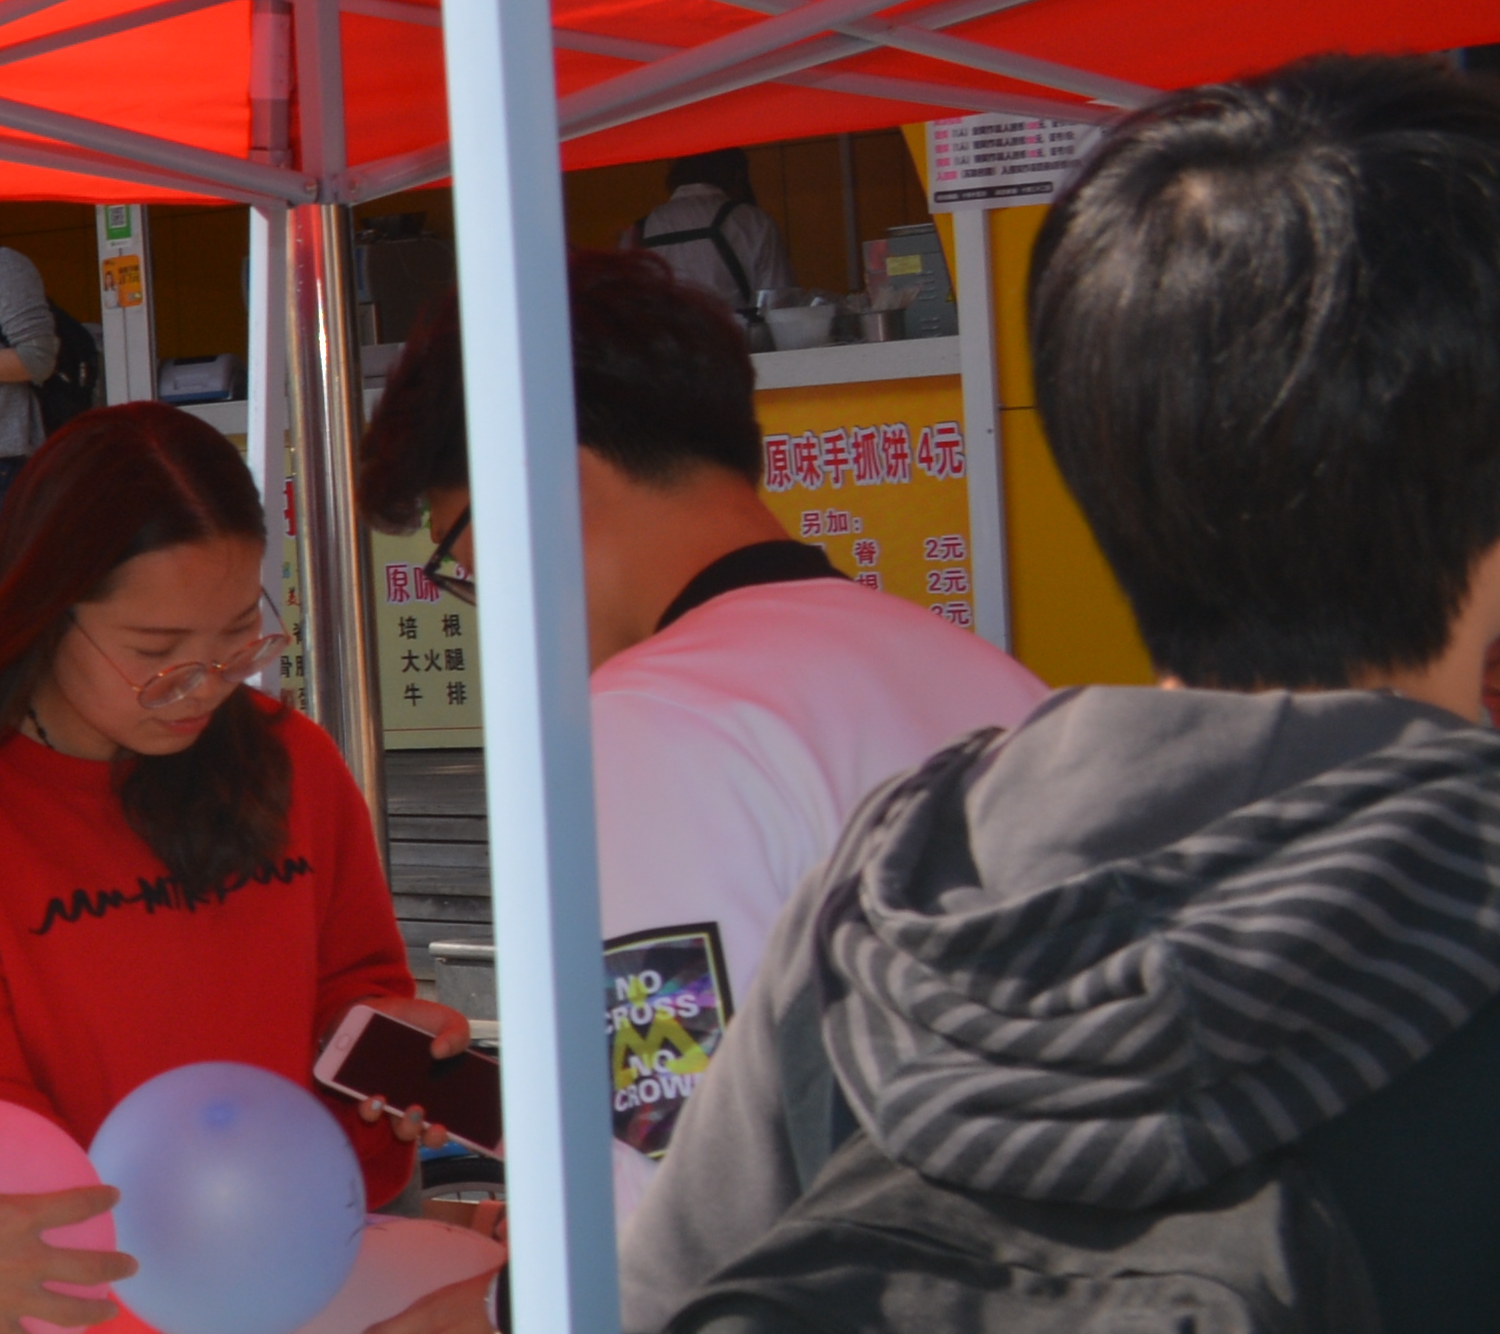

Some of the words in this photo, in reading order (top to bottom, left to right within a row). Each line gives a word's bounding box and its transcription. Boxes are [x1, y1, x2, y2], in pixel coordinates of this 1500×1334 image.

[764, 423, 911, 492] 原味手抓饼
[917, 422, 966, 477] 4元
[925, 535, 965, 560] 2元
[928, 569, 968, 593] 2元
[398, 614, 462, 640] 培根
[401, 648, 466, 673] 大火腿
[403, 681, 467, 706] 牛排
[615, 969, 662, 1001] NO
[628, 1049, 678, 1077] NO
[614, 1075, 700, 1113] CROW
